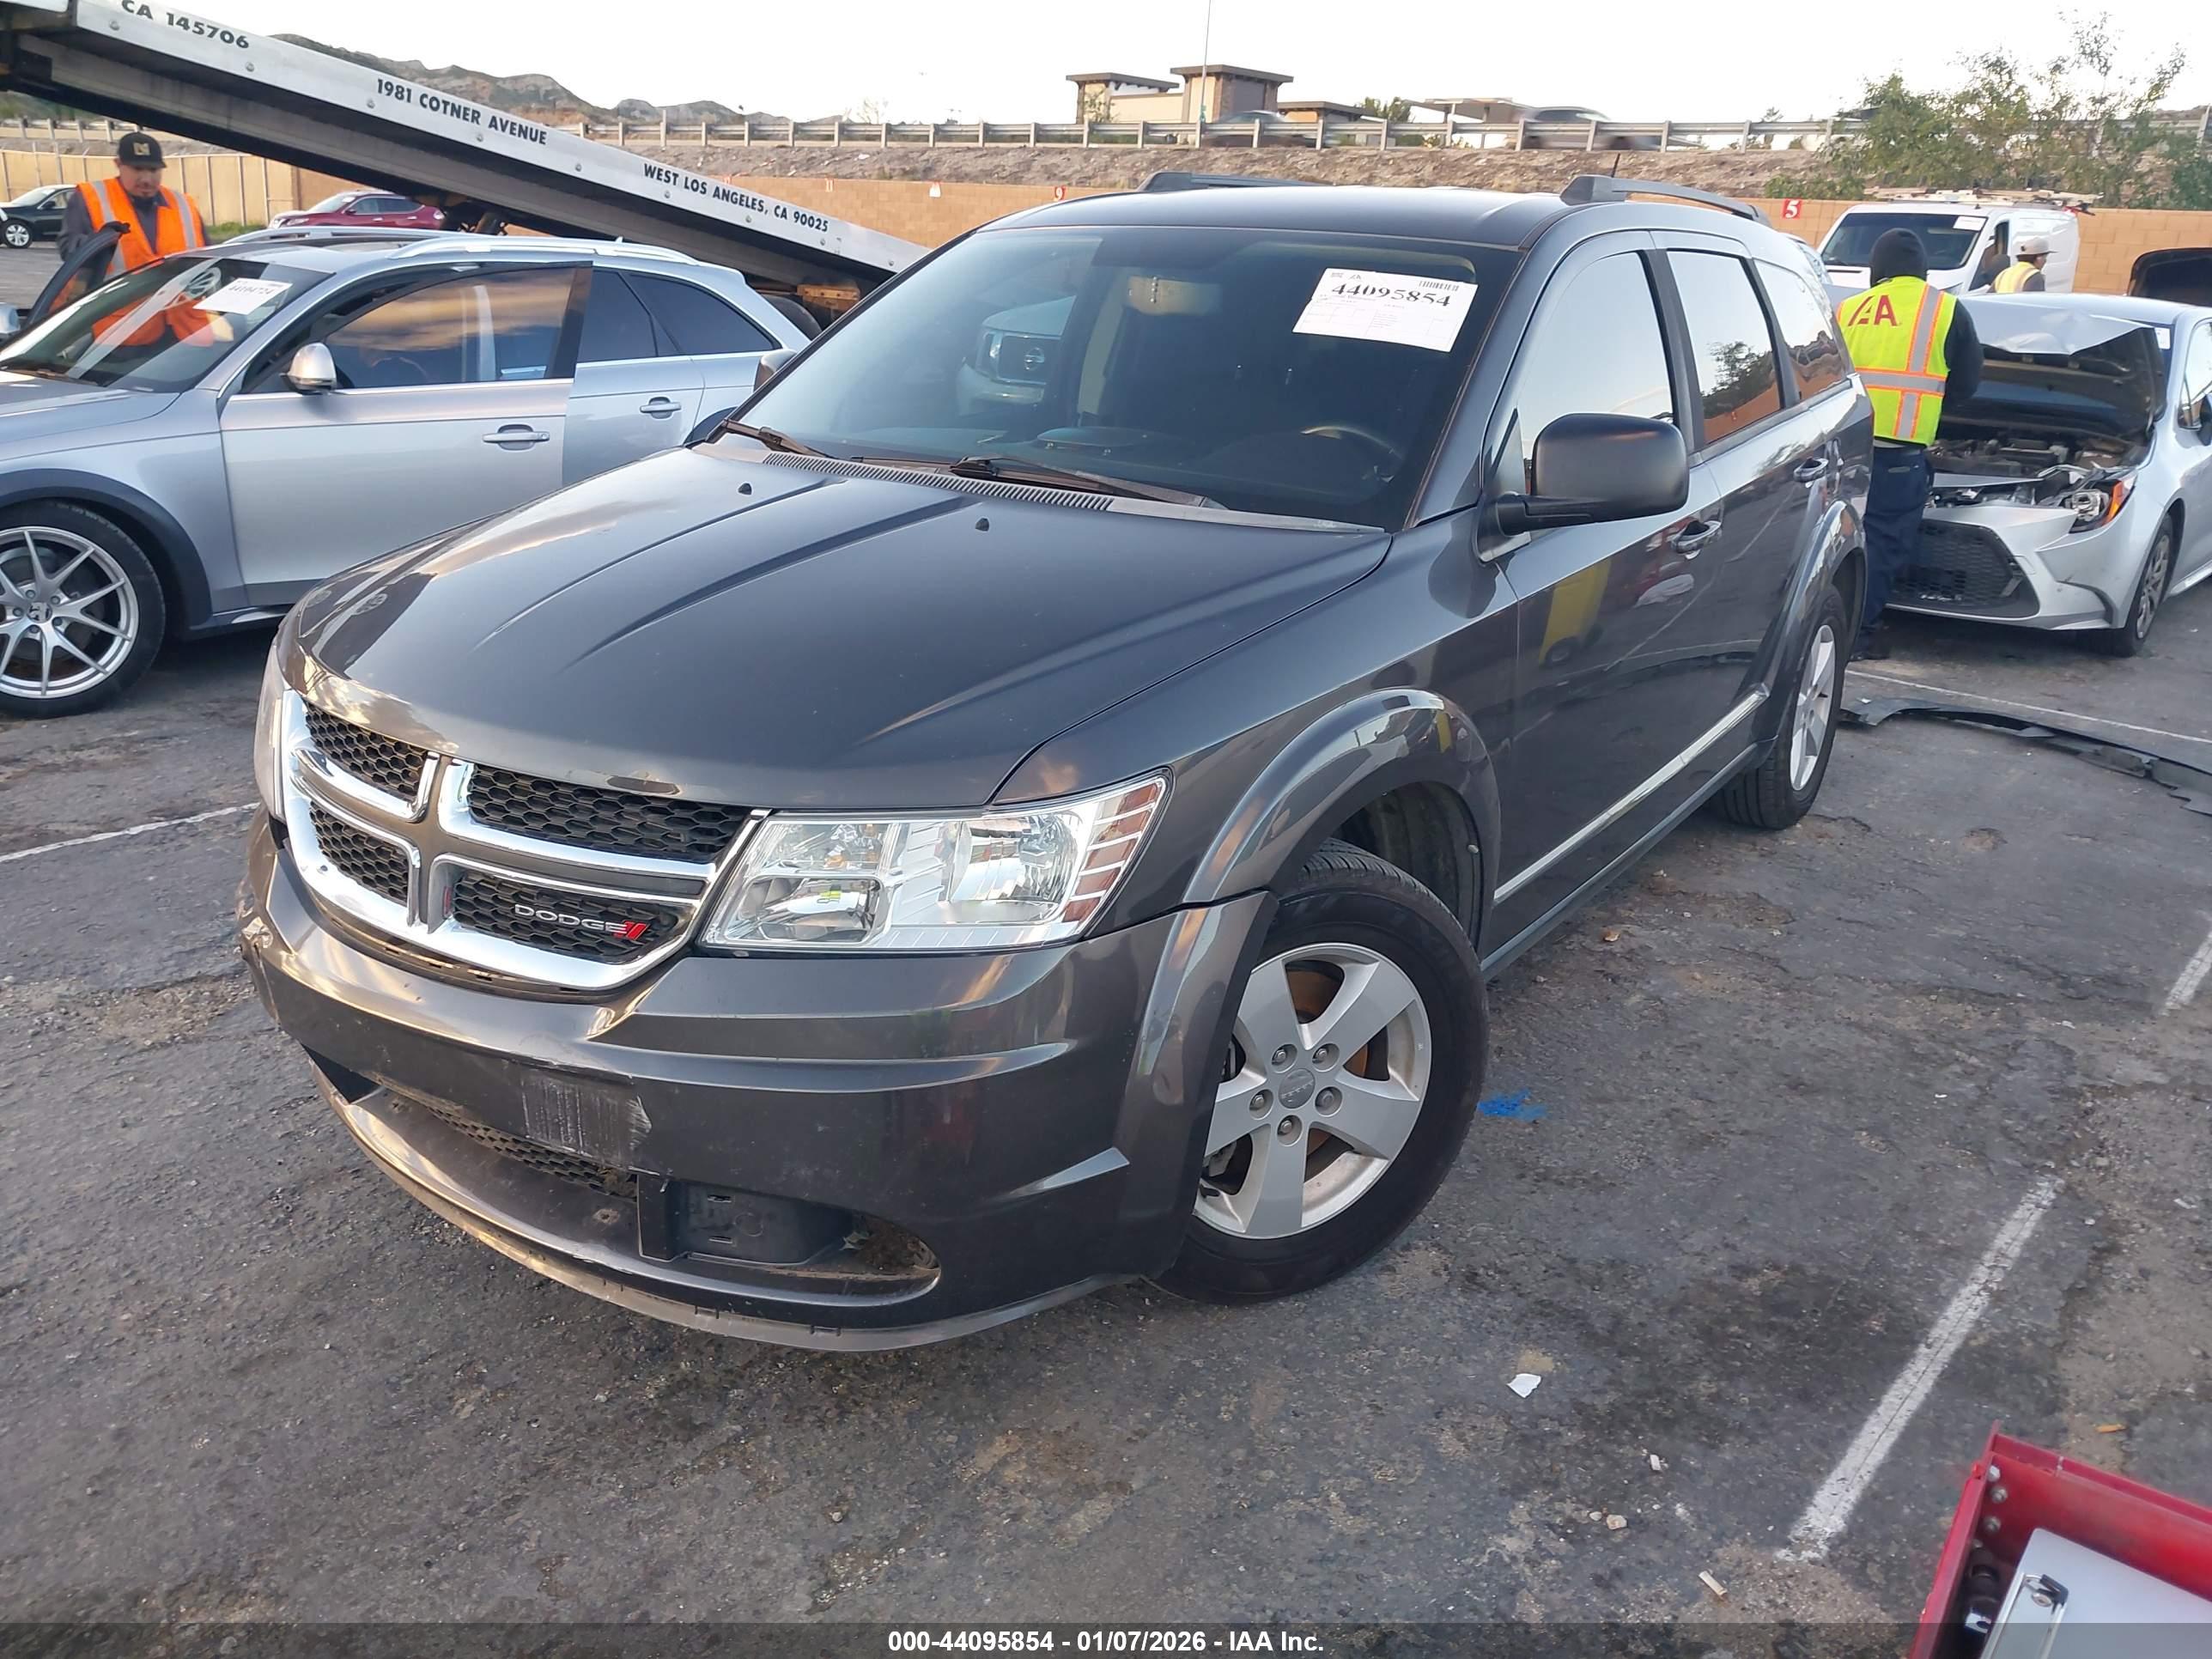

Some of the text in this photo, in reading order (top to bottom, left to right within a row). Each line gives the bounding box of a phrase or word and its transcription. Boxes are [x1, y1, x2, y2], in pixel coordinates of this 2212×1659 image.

[121, 0, 250, 49] CA 145706
[377, 78, 548, 145] 1981 COTNER AVENUE
[643, 162, 679, 186] WEST
[684, 175, 708, 195] LOS
[712, 185, 769, 215] ANGELES,
[773, 204, 788, 221] CA
[793, 210, 830, 233] 90025
[1785, 198, 1800, 218] 5
[1331, 283, 1452, 307] 44095854
[514, 903, 629, 934] DODGE
